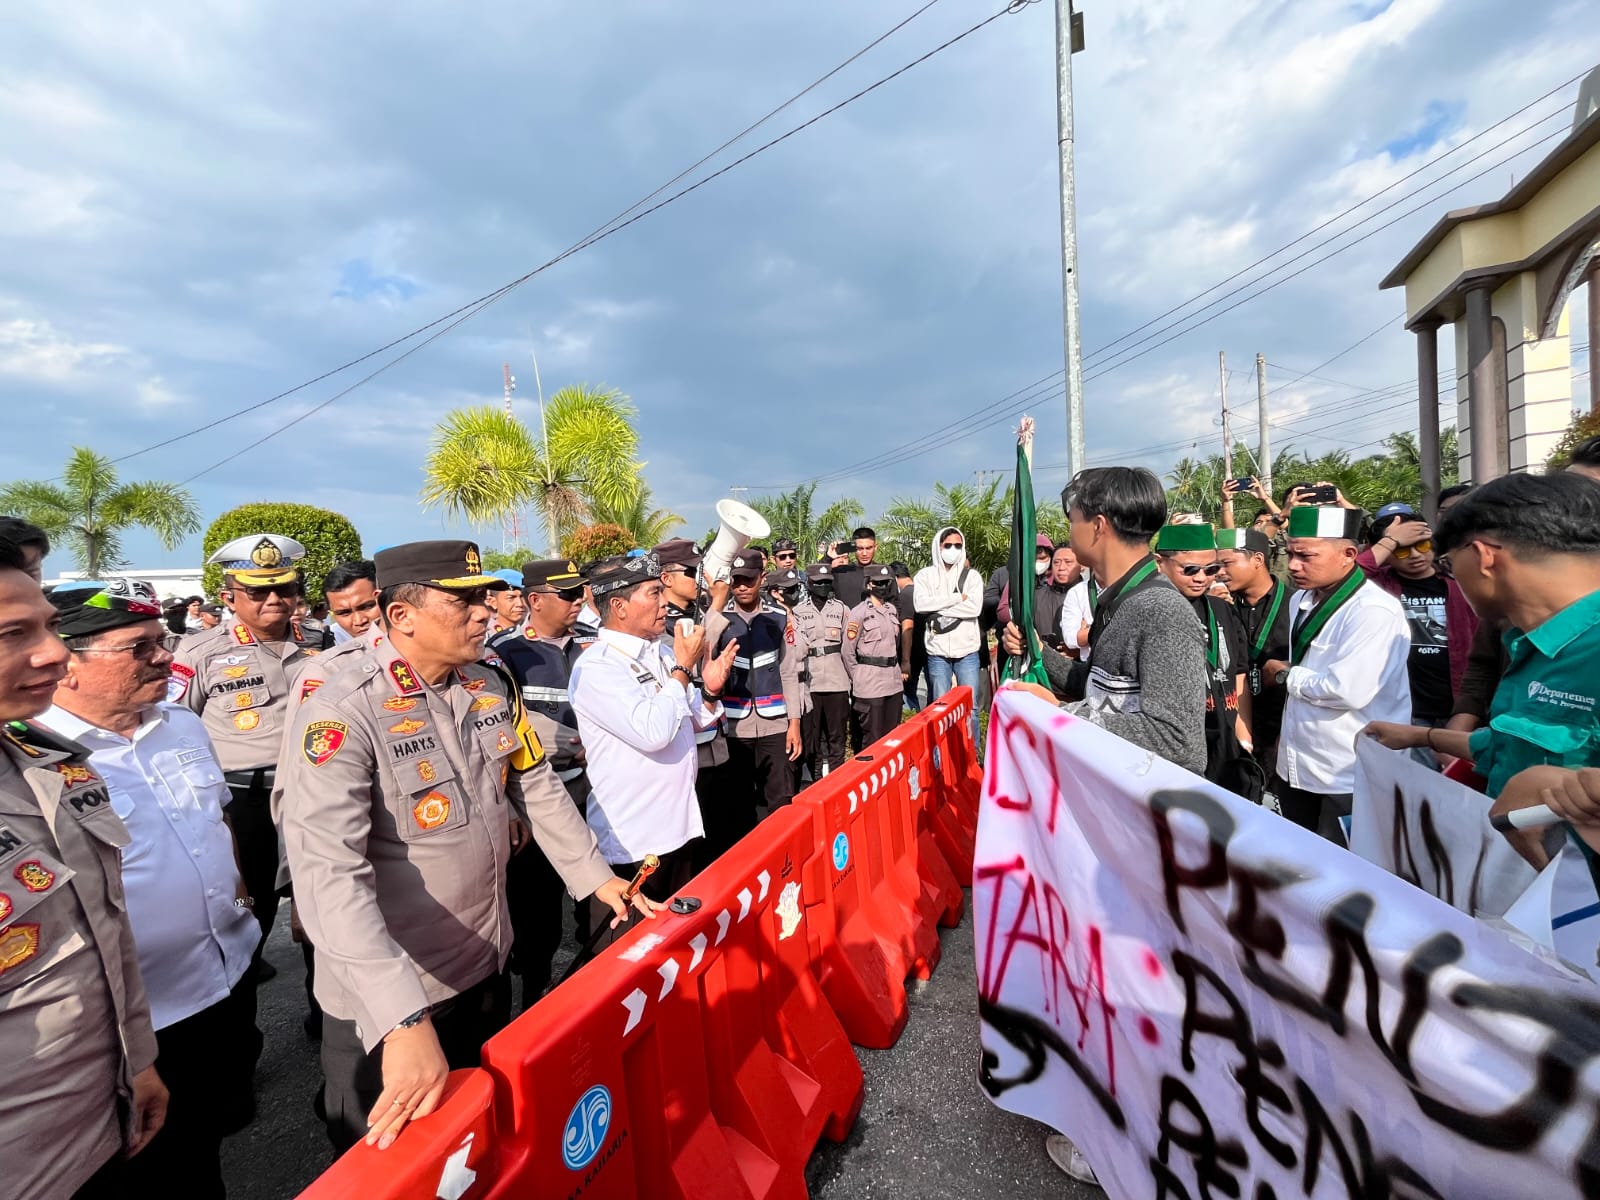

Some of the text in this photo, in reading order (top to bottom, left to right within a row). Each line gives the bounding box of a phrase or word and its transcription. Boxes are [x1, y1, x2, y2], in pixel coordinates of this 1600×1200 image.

[216, 676, 264, 693] SYARHAN
[474, 710, 510, 731] POLRI
[393, 736, 436, 758] HARY.S
